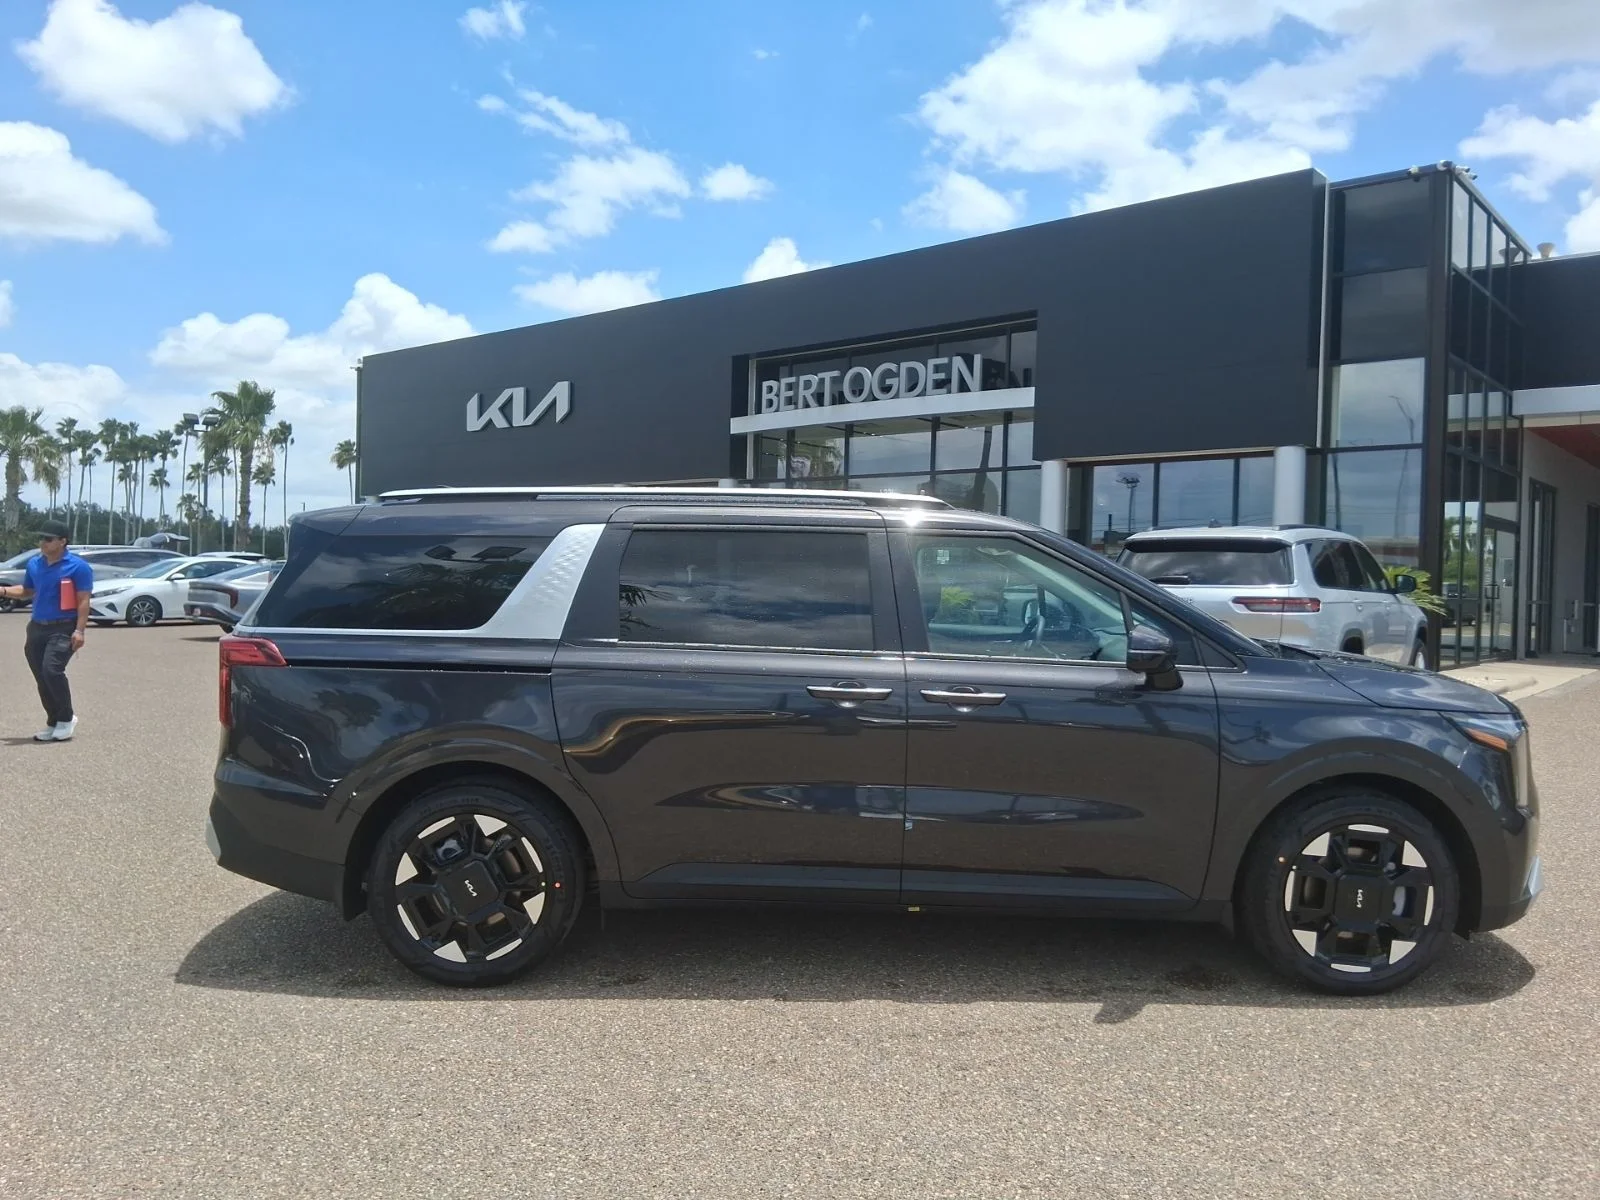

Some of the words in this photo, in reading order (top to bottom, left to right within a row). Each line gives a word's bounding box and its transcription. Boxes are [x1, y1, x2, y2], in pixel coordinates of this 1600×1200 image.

[466, 380, 571, 432] KIA
[761, 370, 841, 415] BERT
[843, 353, 983, 403] OGDEN
